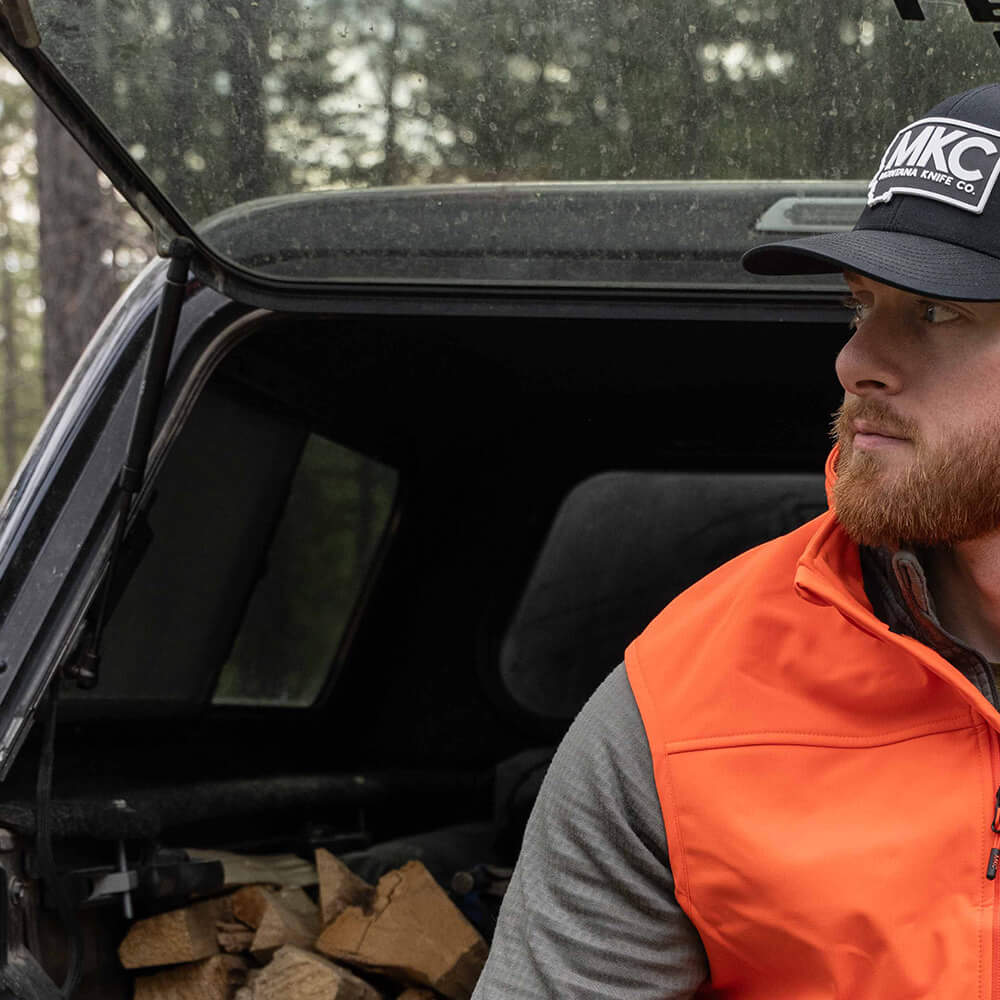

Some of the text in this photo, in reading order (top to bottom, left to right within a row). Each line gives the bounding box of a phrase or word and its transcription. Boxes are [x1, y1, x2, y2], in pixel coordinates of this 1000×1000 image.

[884, 125, 998, 182] MKC
[920, 169, 954, 186] KNIFE
[956, 180, 976, 195] CO.
